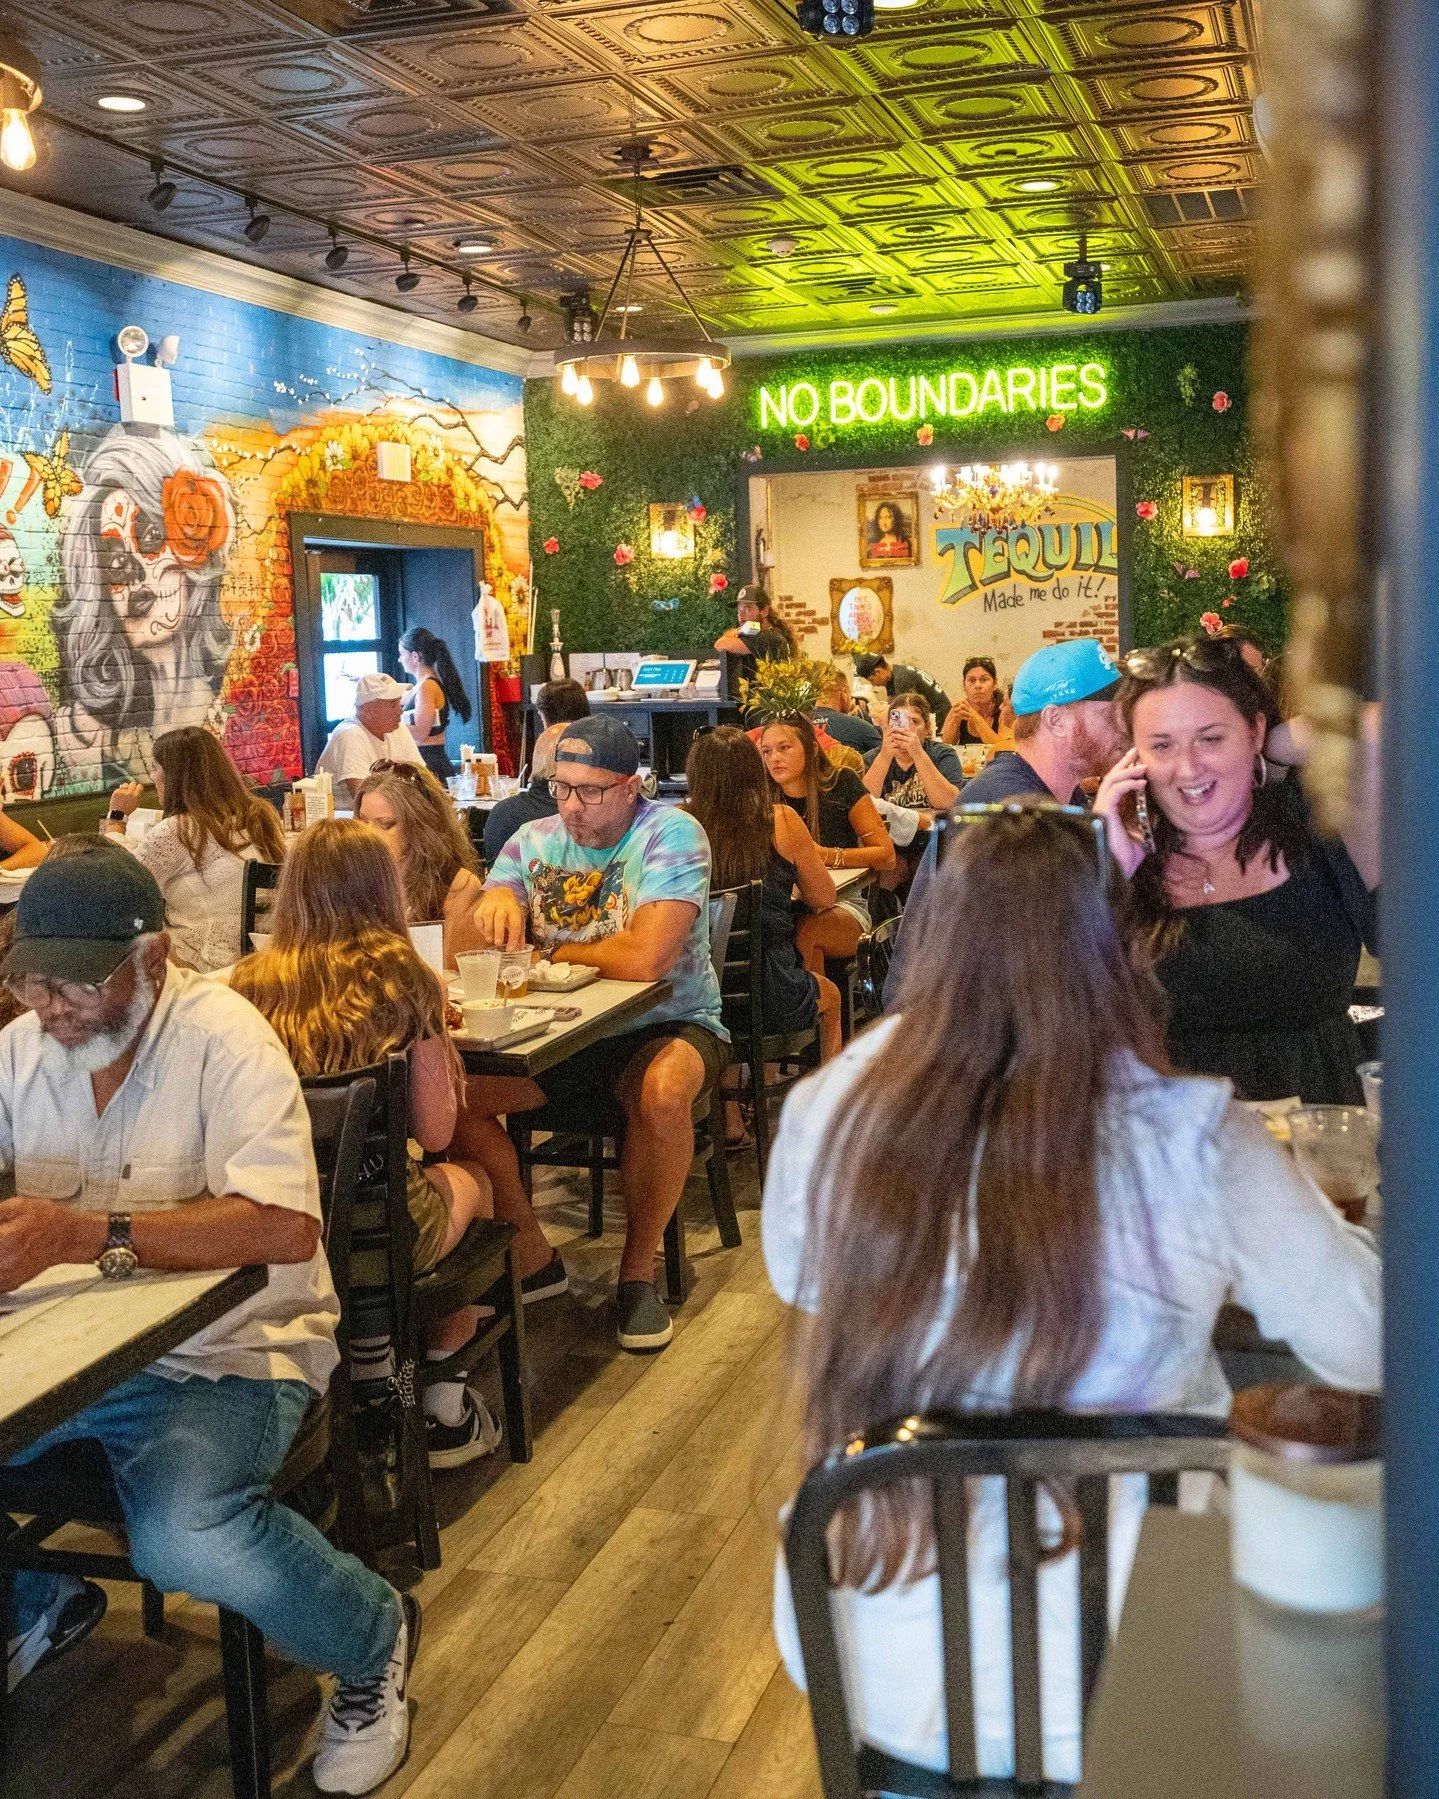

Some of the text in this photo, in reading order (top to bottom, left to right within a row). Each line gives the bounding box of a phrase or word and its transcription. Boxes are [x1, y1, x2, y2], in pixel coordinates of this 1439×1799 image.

[759, 362, 1108, 429] NO BOUNDARIES
[983, 575, 1106, 613] Made me do it!
